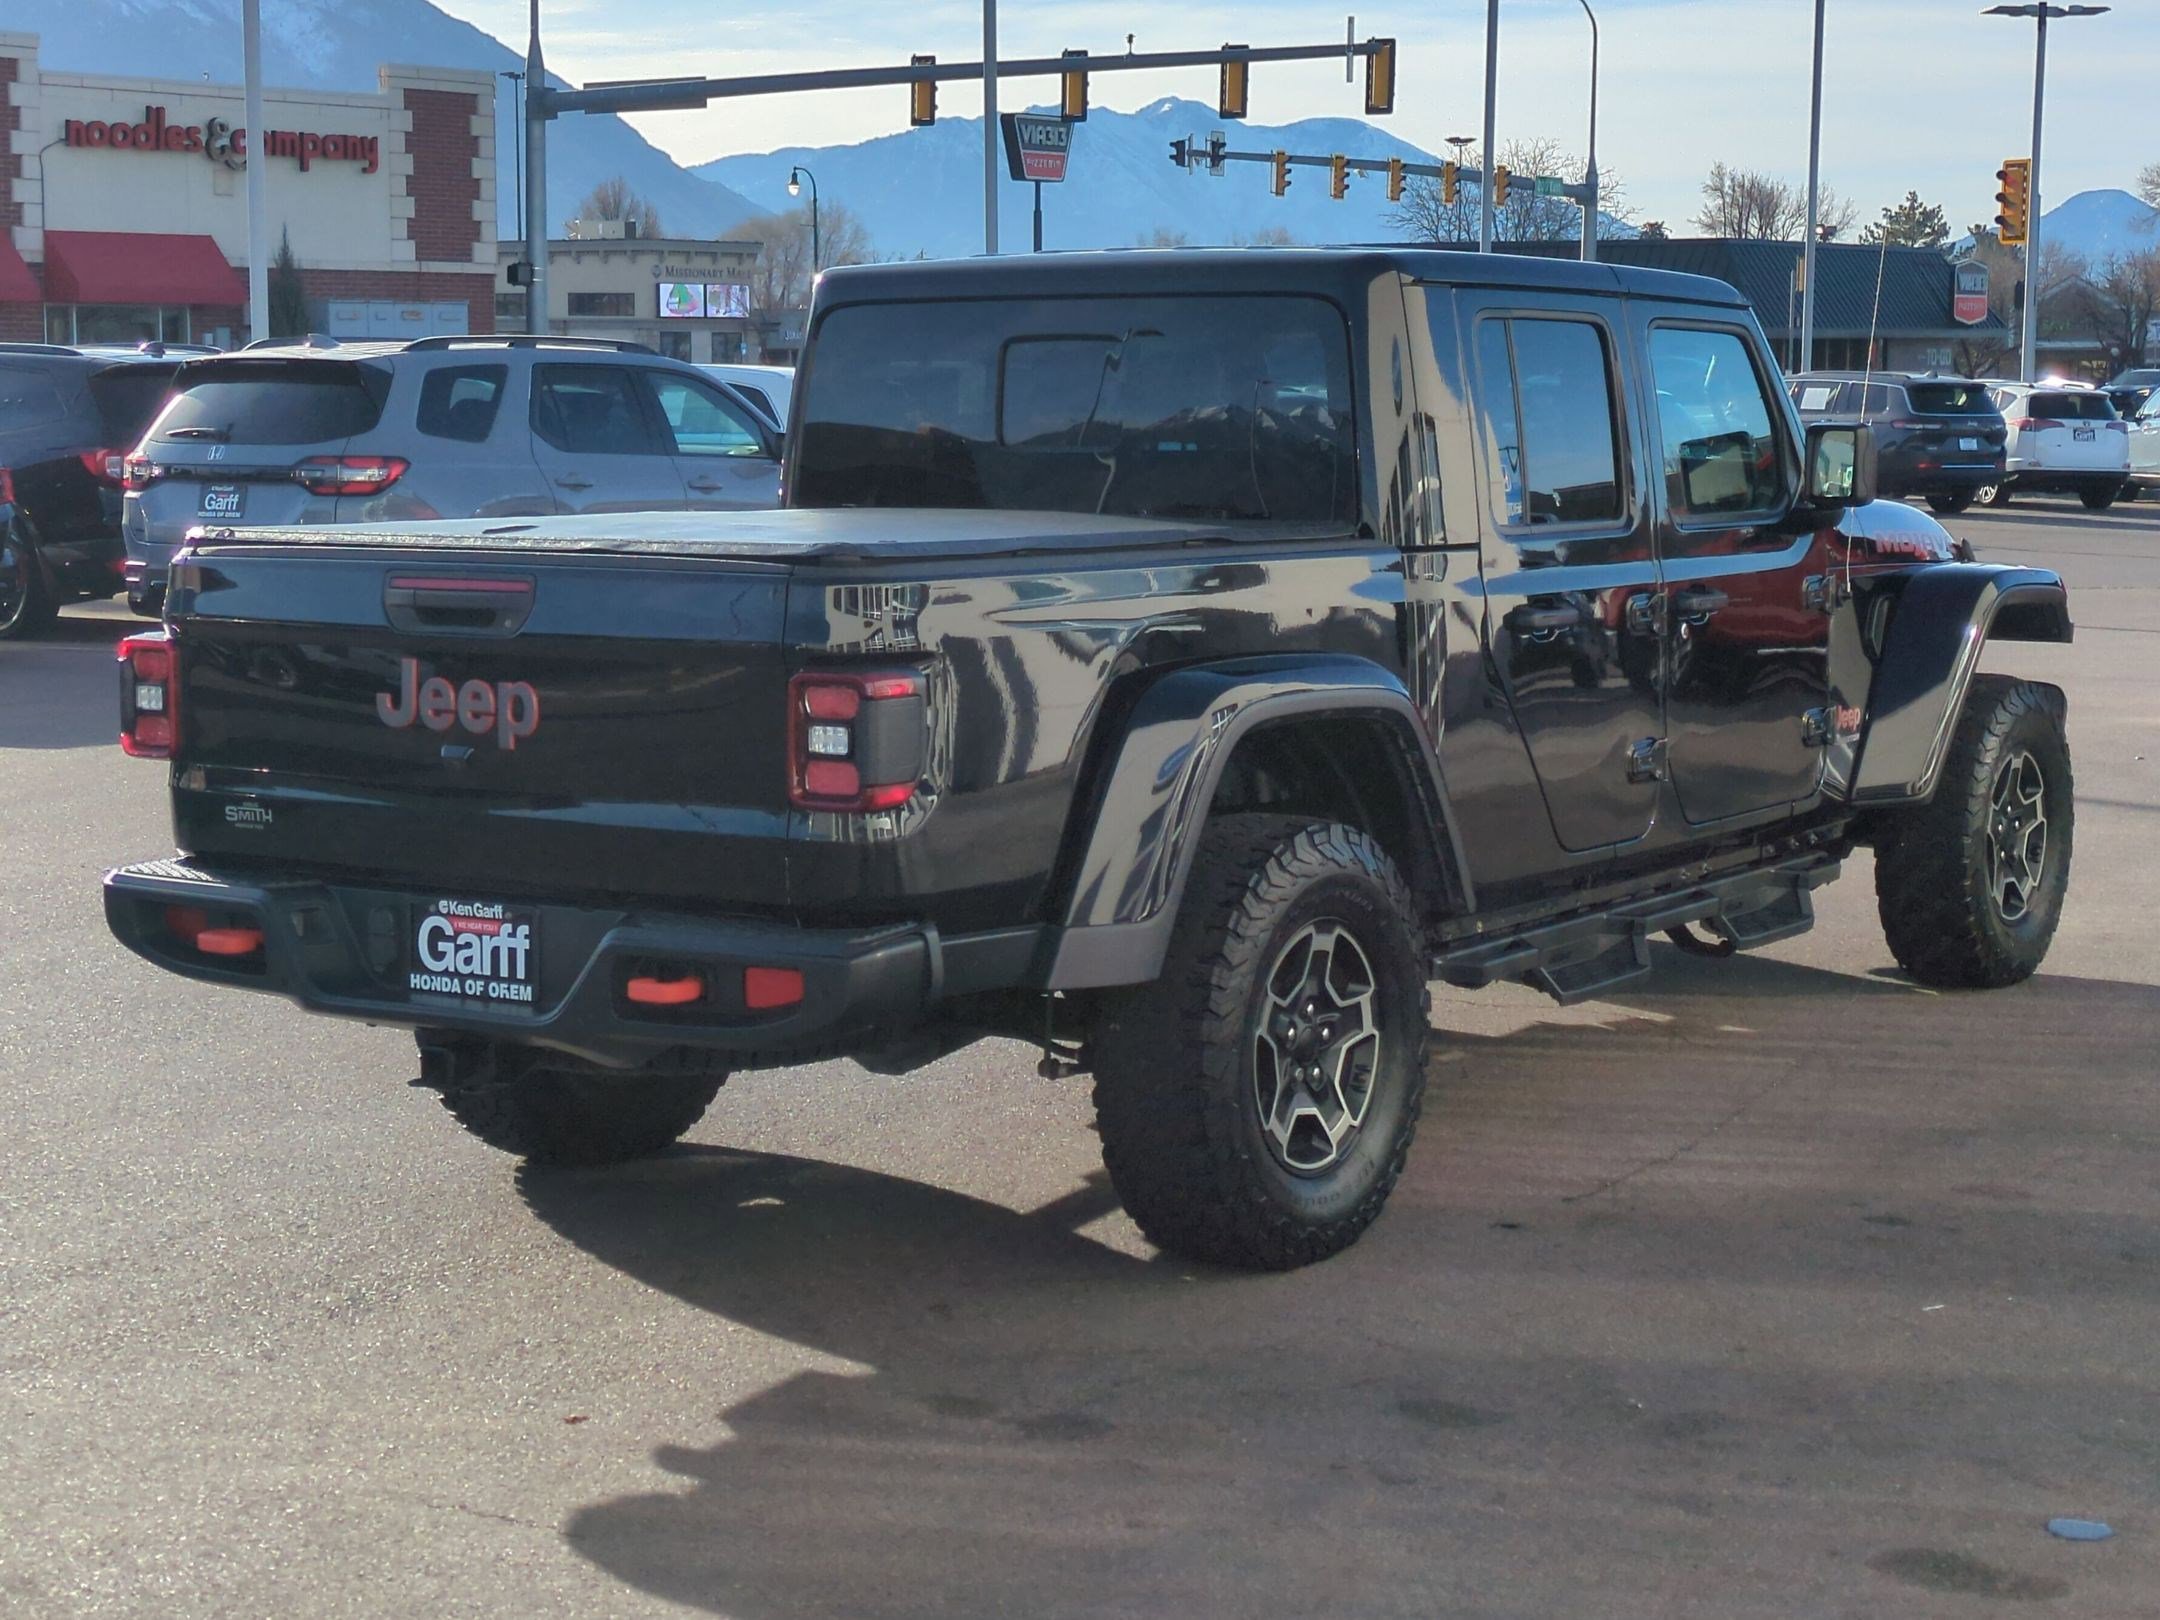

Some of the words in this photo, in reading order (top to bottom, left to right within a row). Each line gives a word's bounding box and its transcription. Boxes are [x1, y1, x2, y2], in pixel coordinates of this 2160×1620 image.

[65, 105, 203, 151] noodles
[229, 127, 379, 174] cmpany
[205, 493, 239, 510] Garff
[376, 657, 539, 750] Jeep
[1835, 704, 1861, 732] Jeep
[225, 805, 273, 823] SMITH
[418, 915, 530, 980] Garff
[410, 973, 461, 994] HONDA
[465, 979, 485, 996] OF
[488, 981, 532, 1001] OREM
